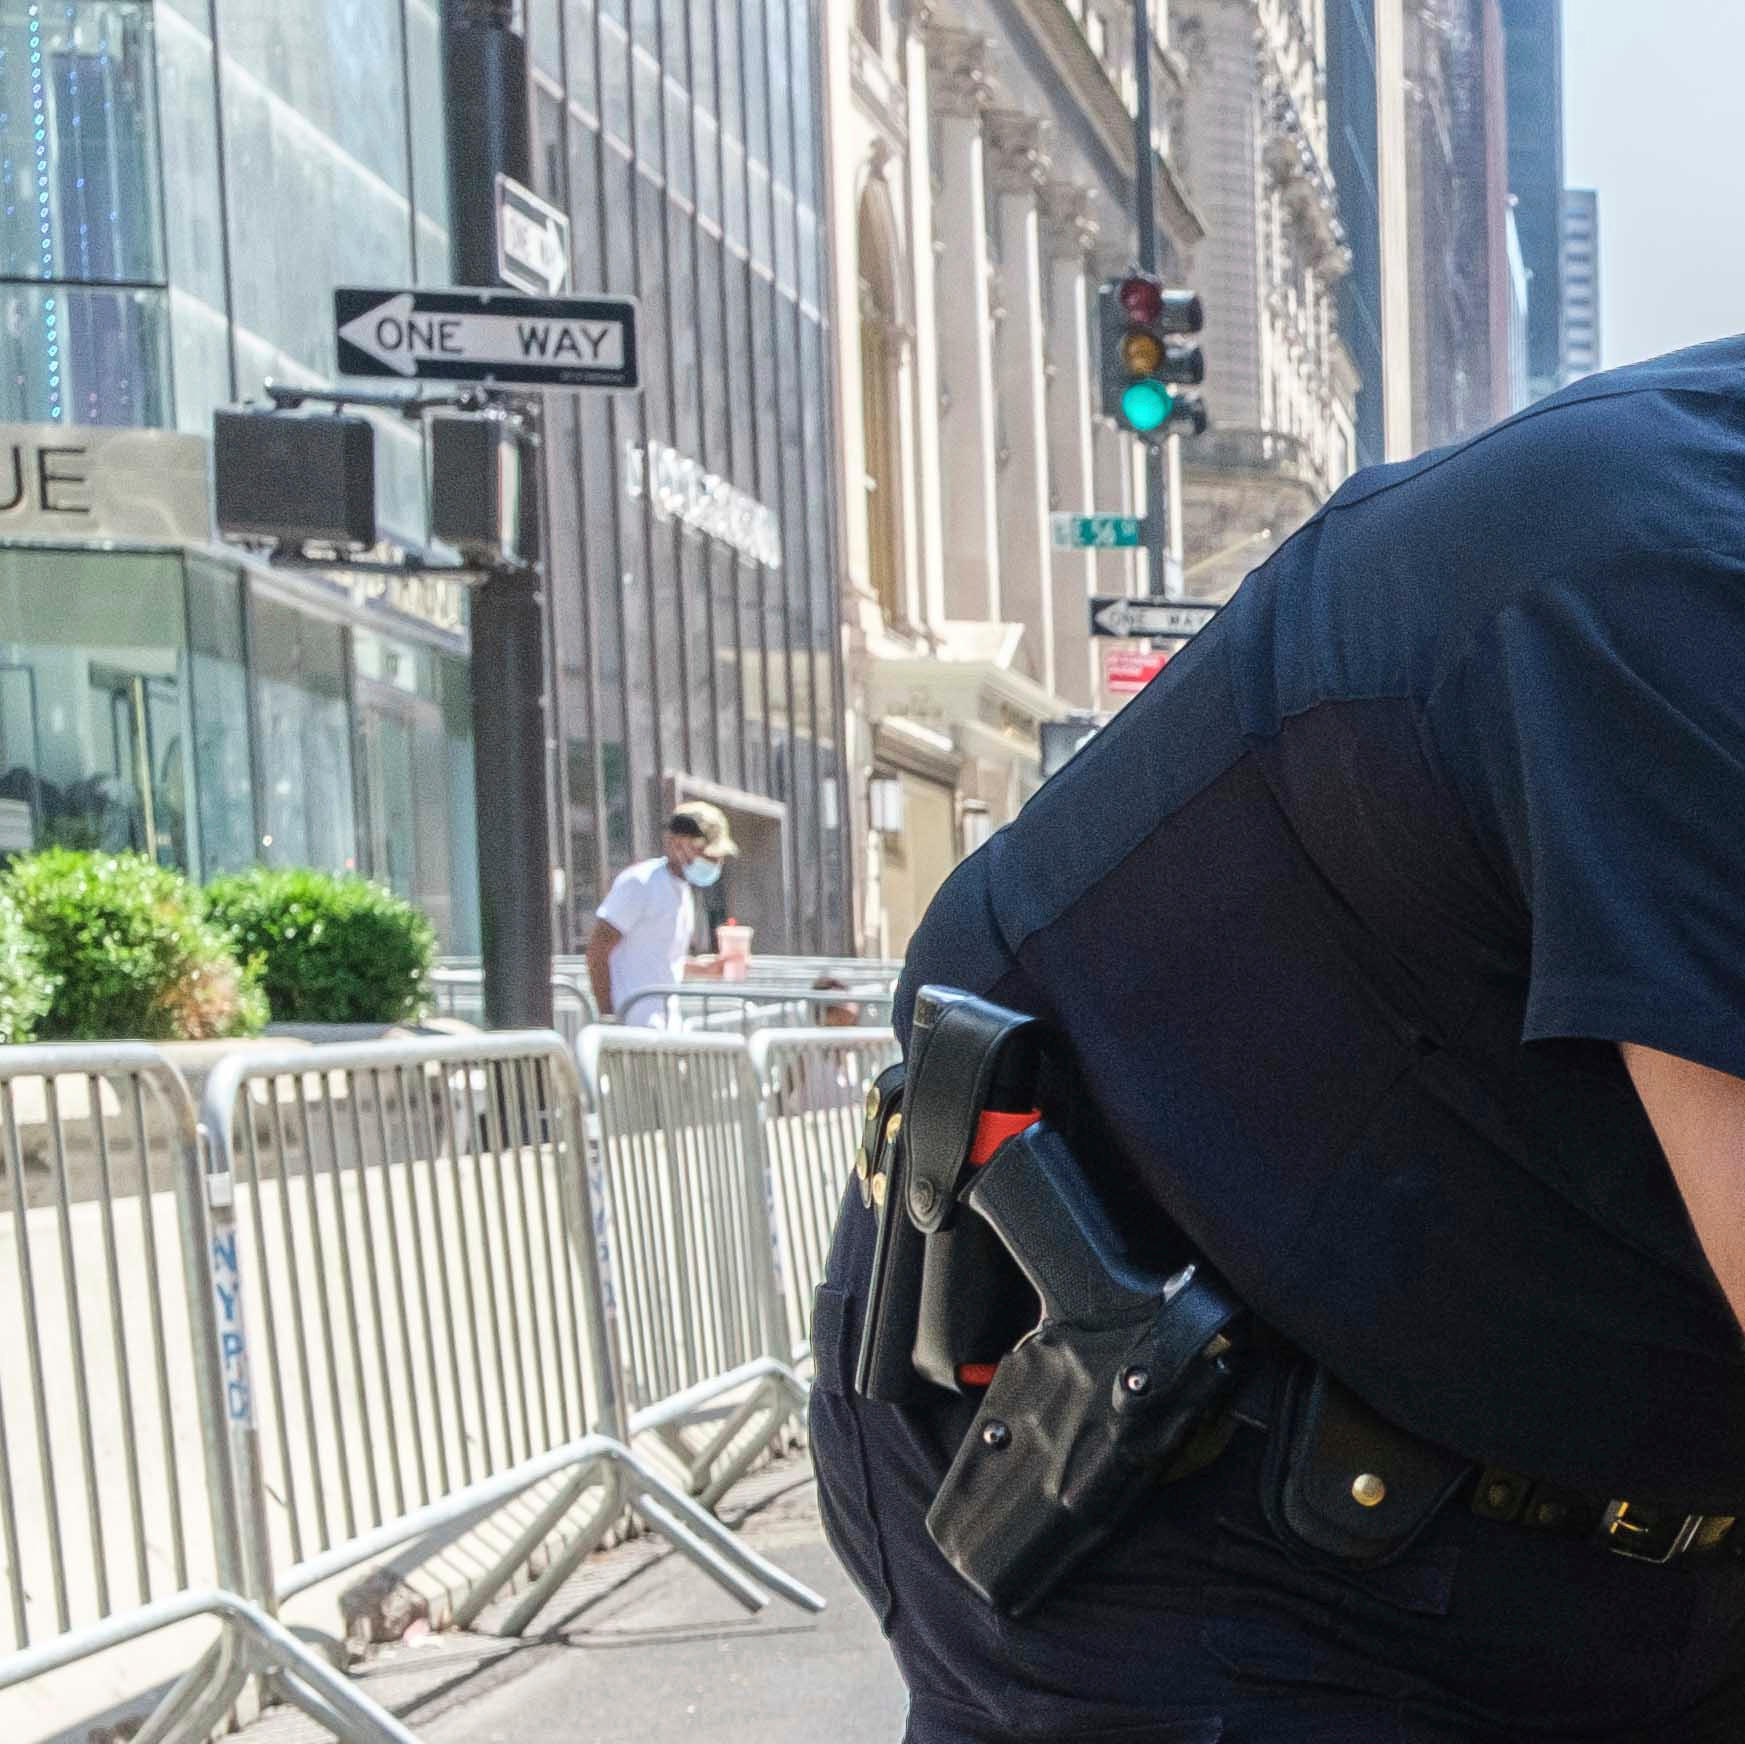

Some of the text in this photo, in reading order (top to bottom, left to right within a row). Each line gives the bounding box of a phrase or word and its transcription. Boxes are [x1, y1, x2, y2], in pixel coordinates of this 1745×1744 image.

[376, 317, 609, 359] ONE WAY
[211, 1230, 249, 1420] NYPD
